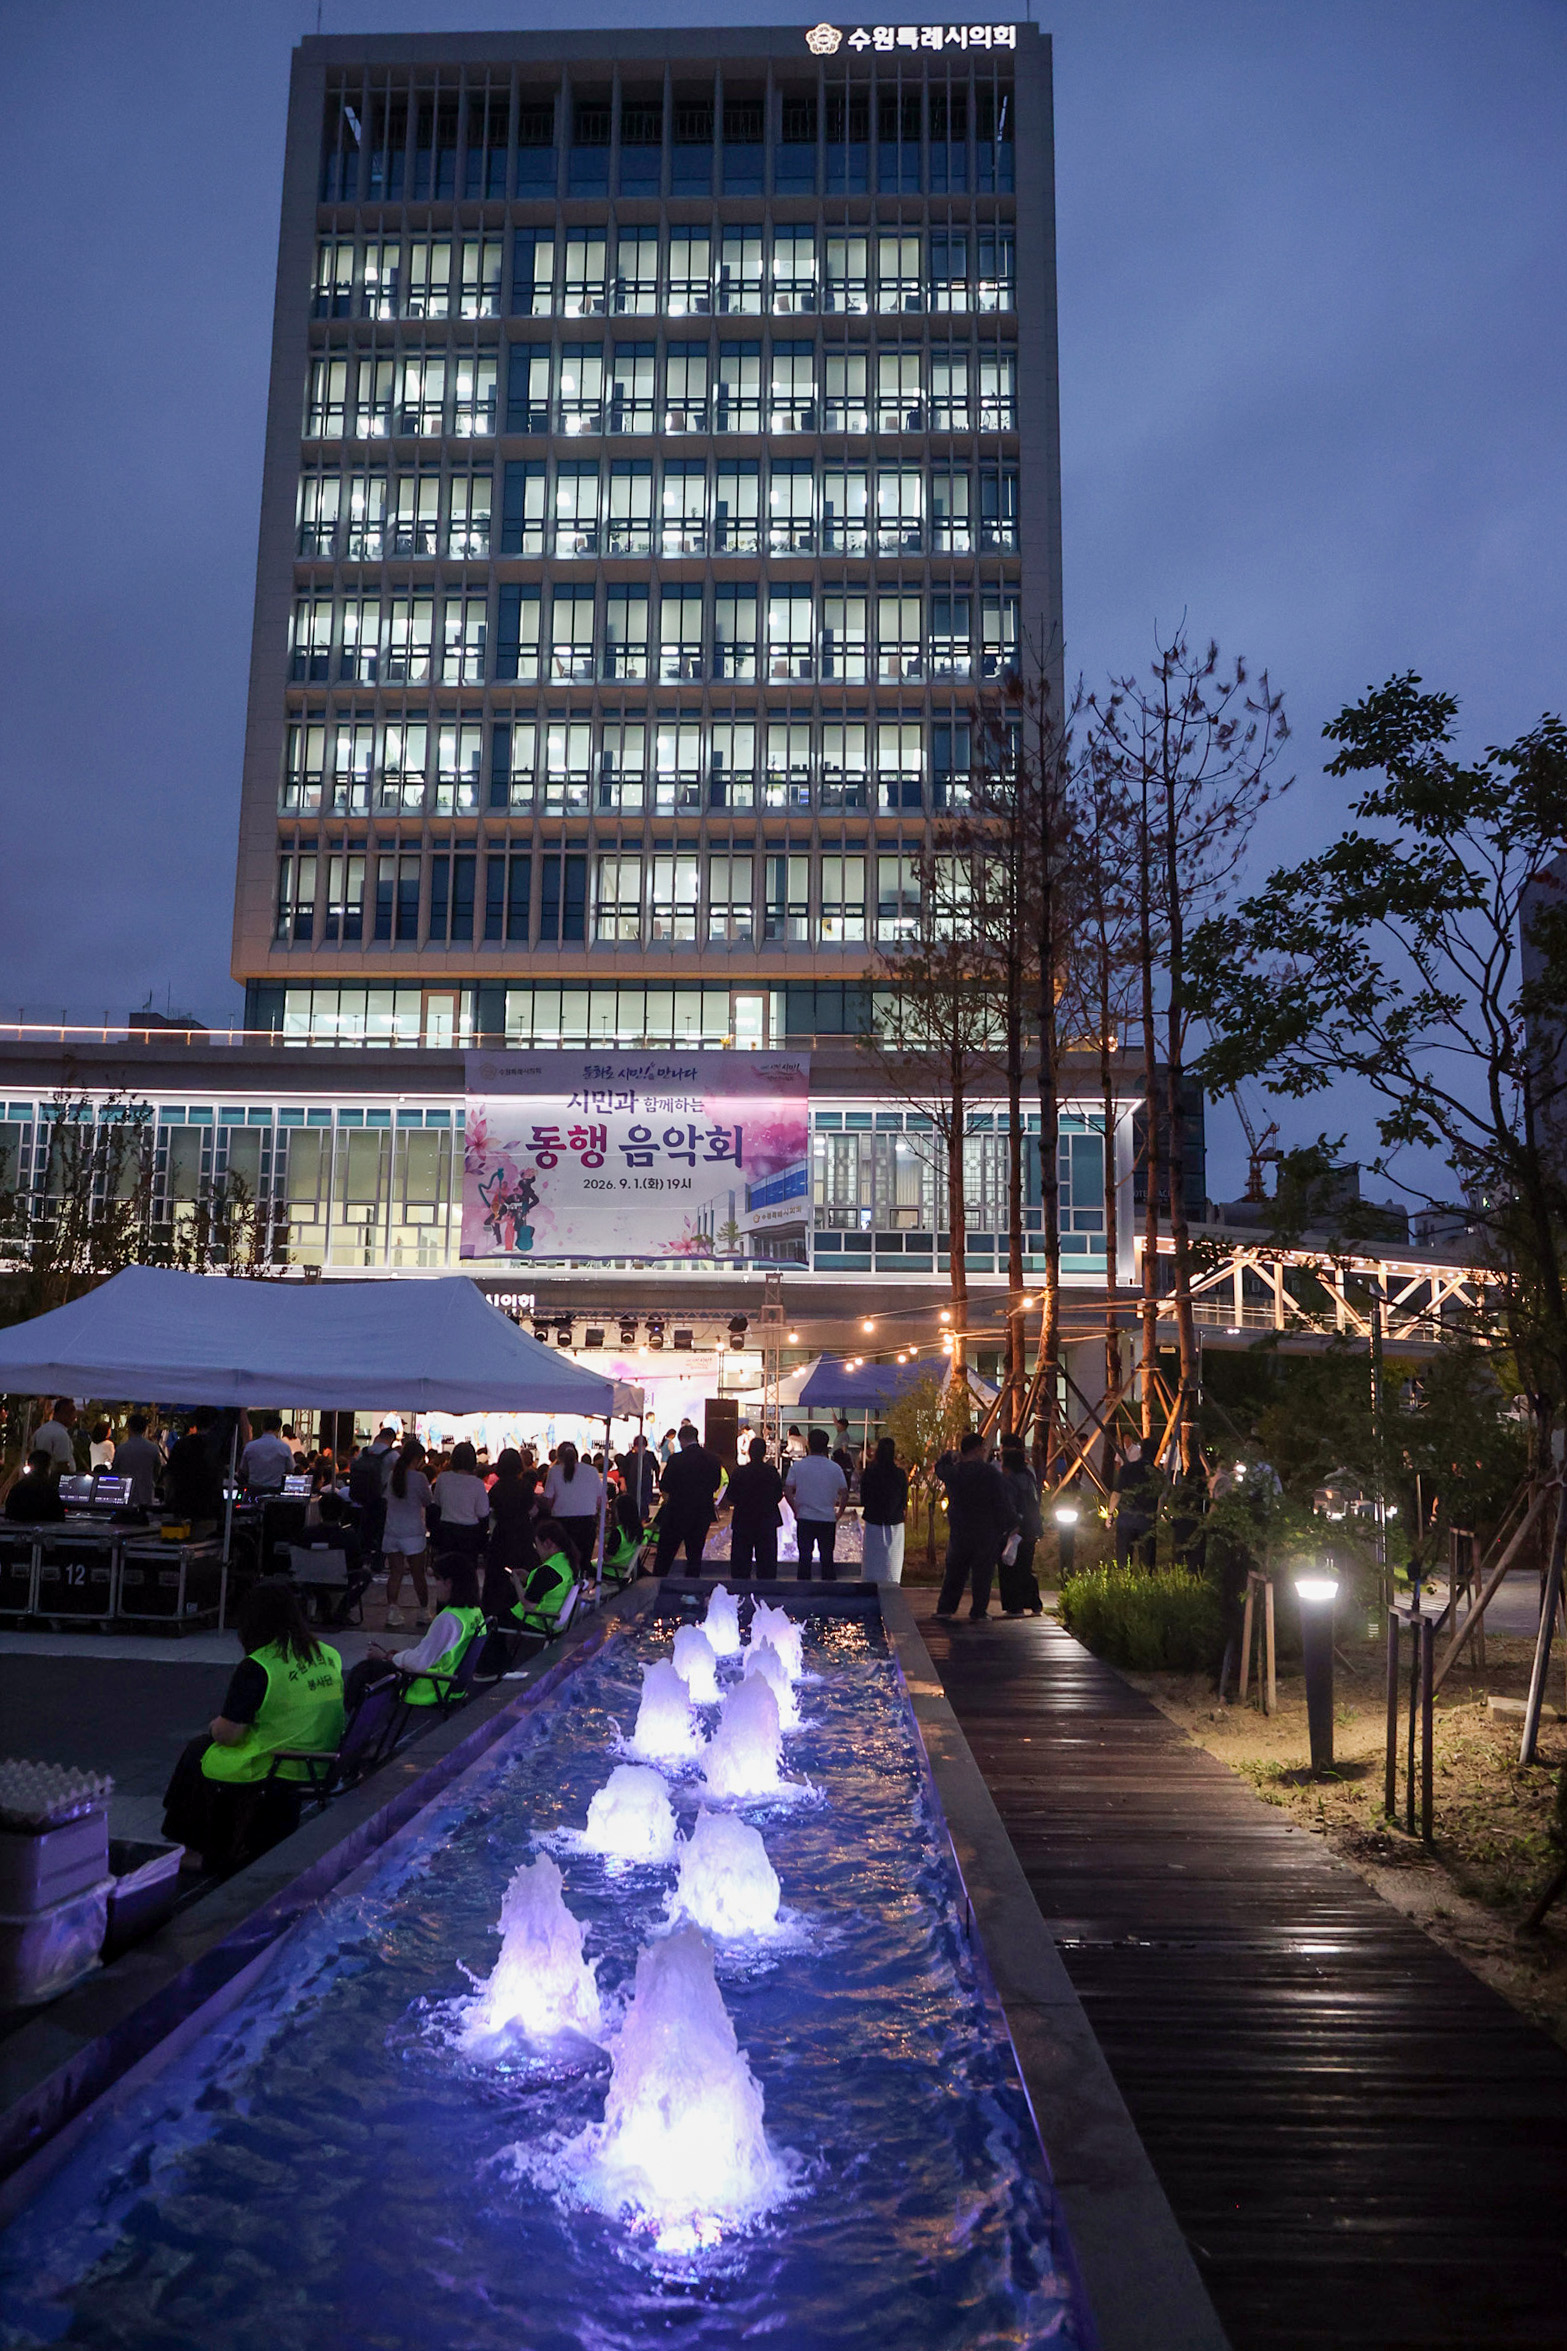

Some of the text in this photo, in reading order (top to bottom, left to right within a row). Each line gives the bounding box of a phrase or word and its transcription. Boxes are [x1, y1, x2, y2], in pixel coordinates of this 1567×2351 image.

[848, 25, 1017, 51] 수원특례시의회
[657, 1065, 698, 1080] 만나다
[567, 1089, 704, 1114] 시민과 함께하는
[525, 1123, 743, 1169] 동행 음악회
[583, 1178, 617, 1190] 2026.
[667, 1178, 692, 1190] 19시
[66, 1564, 85, 1585] 12
